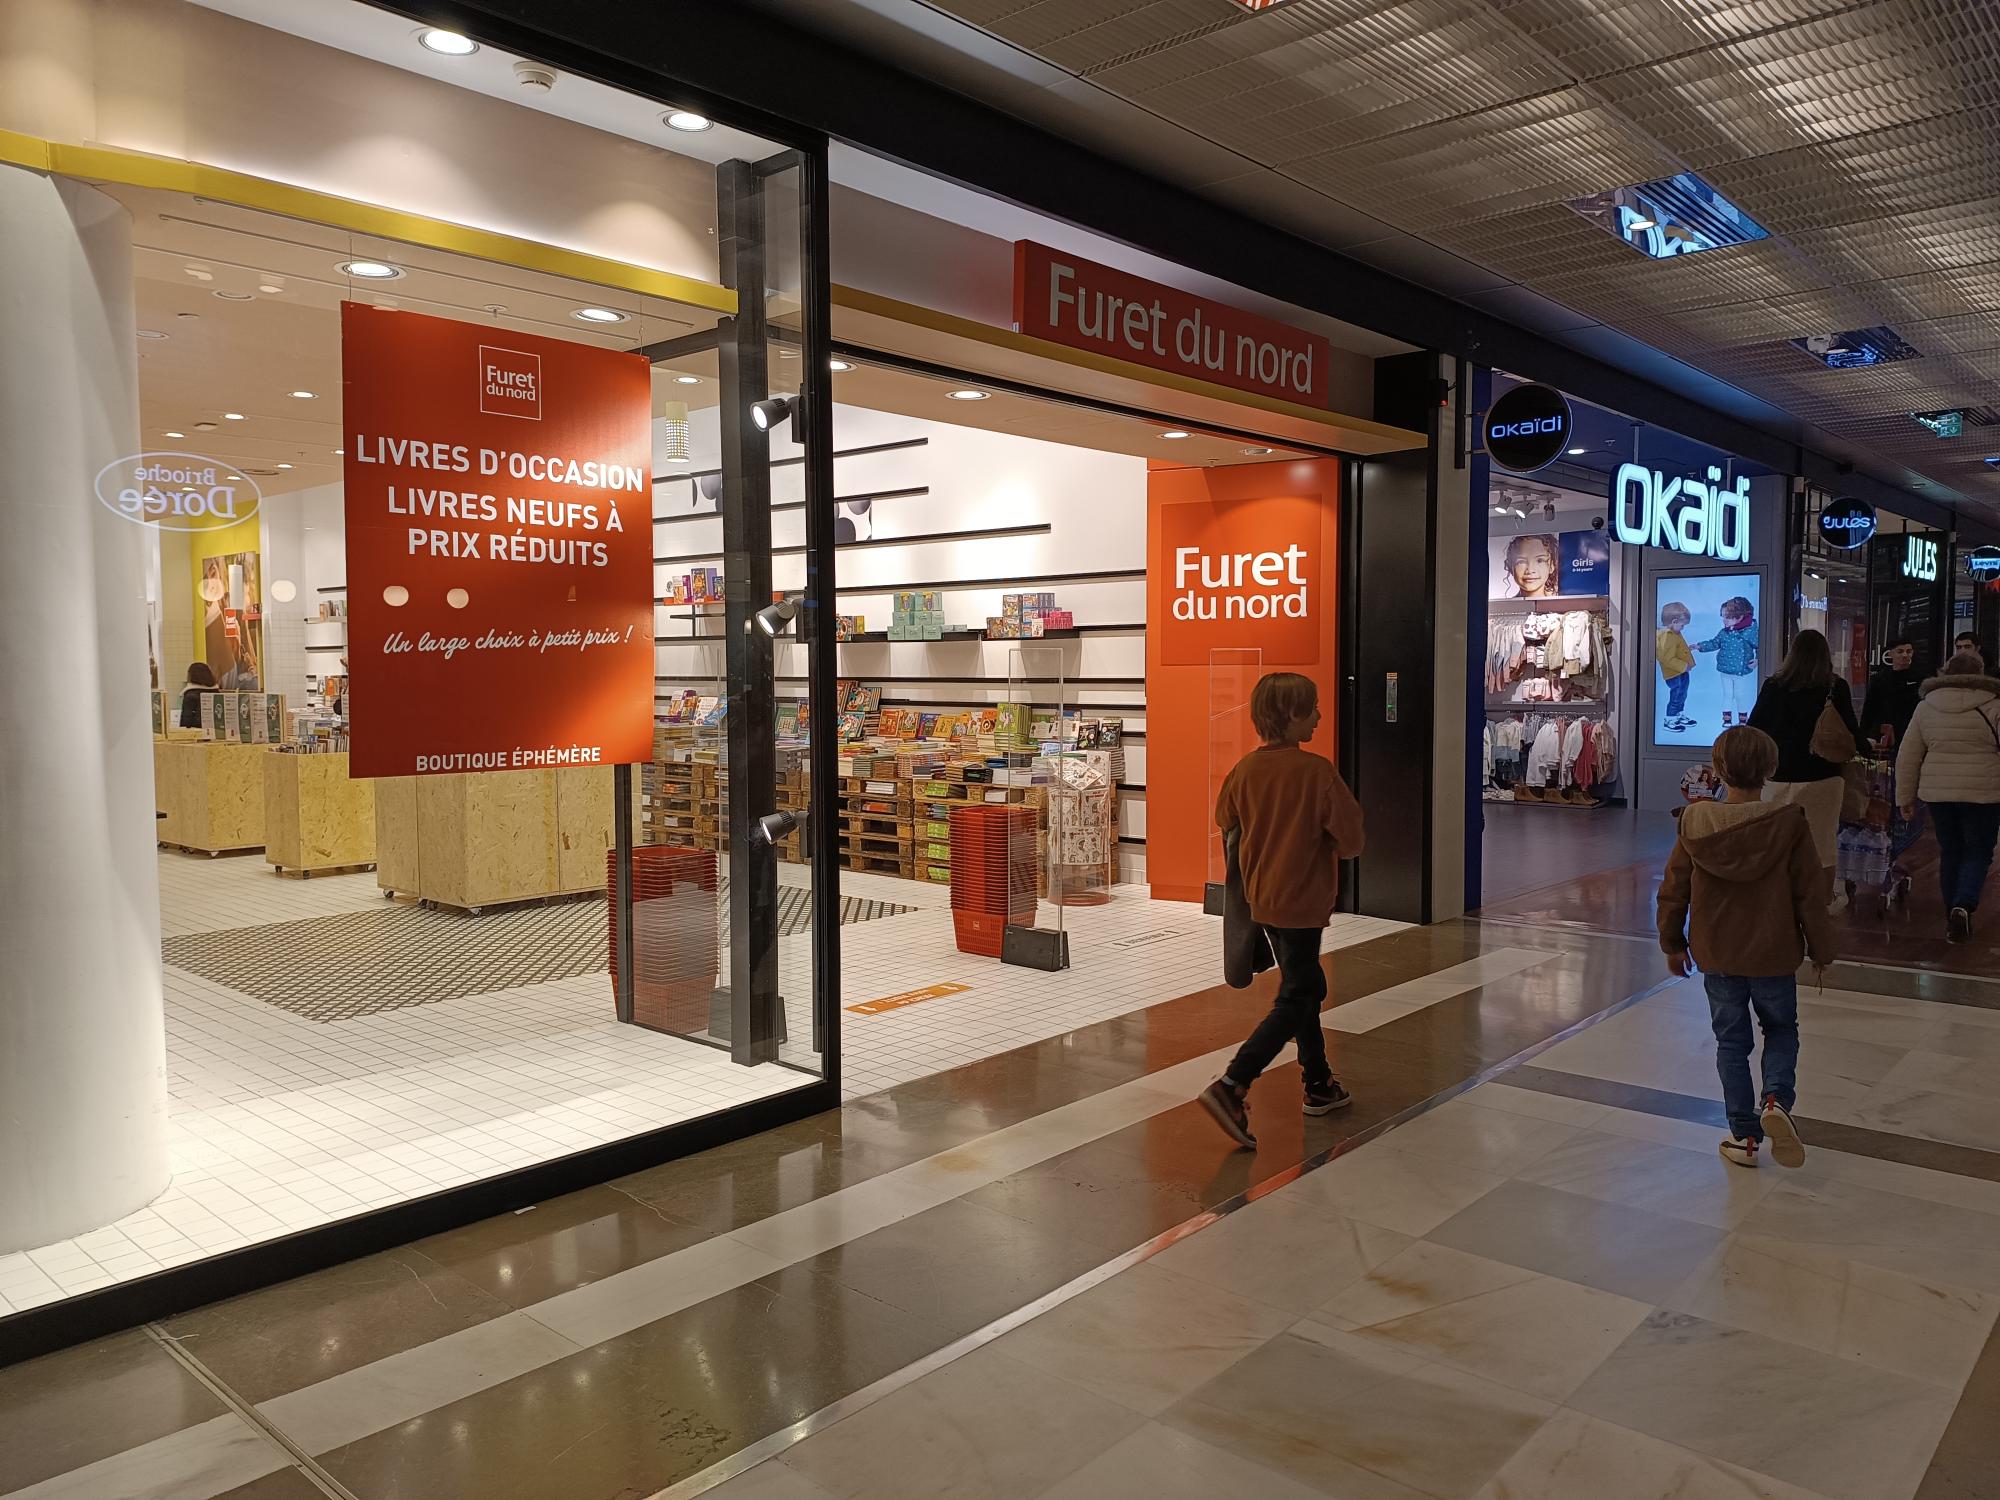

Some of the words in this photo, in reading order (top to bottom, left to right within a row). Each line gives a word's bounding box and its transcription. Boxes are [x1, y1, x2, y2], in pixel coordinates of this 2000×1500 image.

[1050, 261, 1167, 356] Furet
[1176, 308, 1224, 371] du
[1236, 334, 1312, 394] nord
[486, 365, 535, 389] Furet
[486, 382, 504, 396] du
[506, 386, 536, 401] nord
[357, 434, 470, 473] LIVRES
[480, 448, 643, 493] D'OCCASION
[388, 486, 498, 522] LIVRES
[507, 497, 599, 531] NEUFS
[605, 500, 624, 533] À
[408, 528, 481, 559] PRIX
[489, 528, 609, 567] RÉDUITS
[1572, 557, 1594, 567] Girls
[1903, 535, 1938, 582] JULES
[1176, 543, 1307, 589] Furet
[1172, 590, 1217, 620] du
[1225, 586, 1308, 619] nord
[383, 631, 413, 653] Un
[417, 631, 471, 660] large
[475, 628, 525, 649] choix
[528, 629, 541, 647] à
[540, 628, 582, 653] petit
[580, 627, 621, 652] prix
[416, 752, 508, 772] BOUTIQUE
[512, 744, 601, 766] ÉPHÉMÈRE
